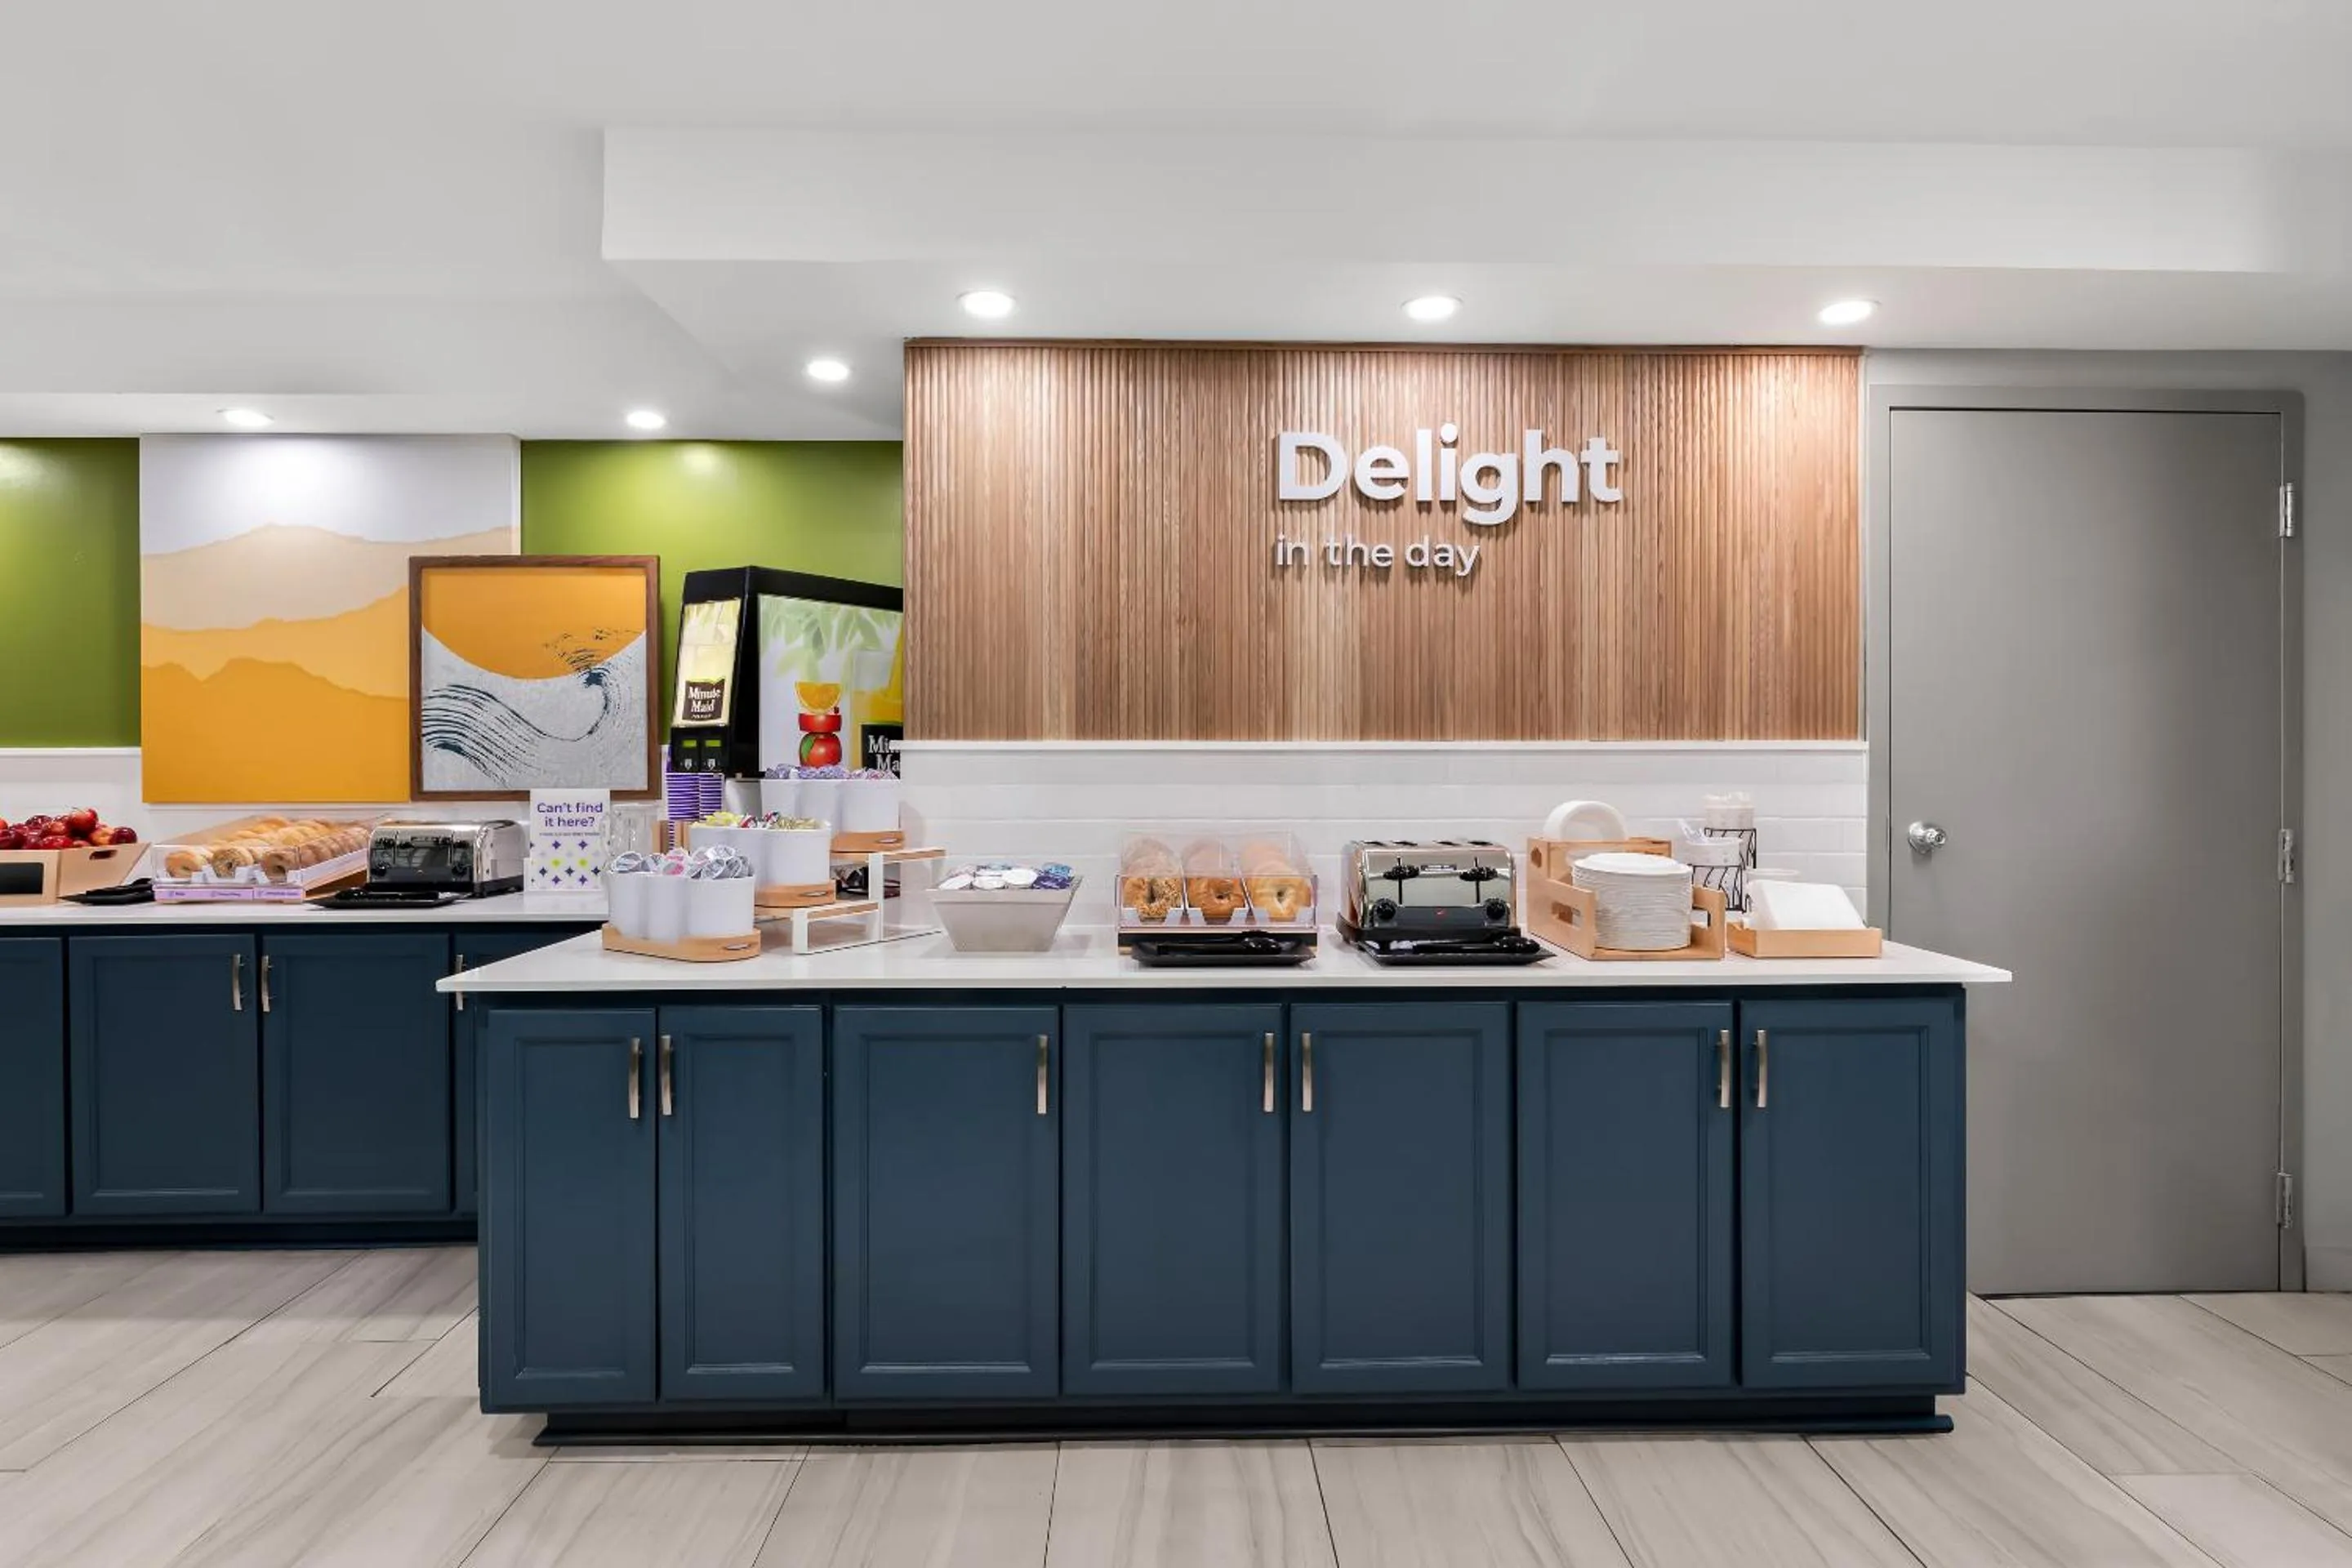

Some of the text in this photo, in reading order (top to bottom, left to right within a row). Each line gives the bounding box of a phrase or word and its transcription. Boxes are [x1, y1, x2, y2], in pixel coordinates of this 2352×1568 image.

[1278, 423, 1623, 526] Delight
[1276, 532, 1481, 577] in the day
[688, 686, 721, 699] Minute
[691, 699, 715, 712] Maid
[537, 802, 603, 813] Can't find
[545, 816, 595, 827] it here?
